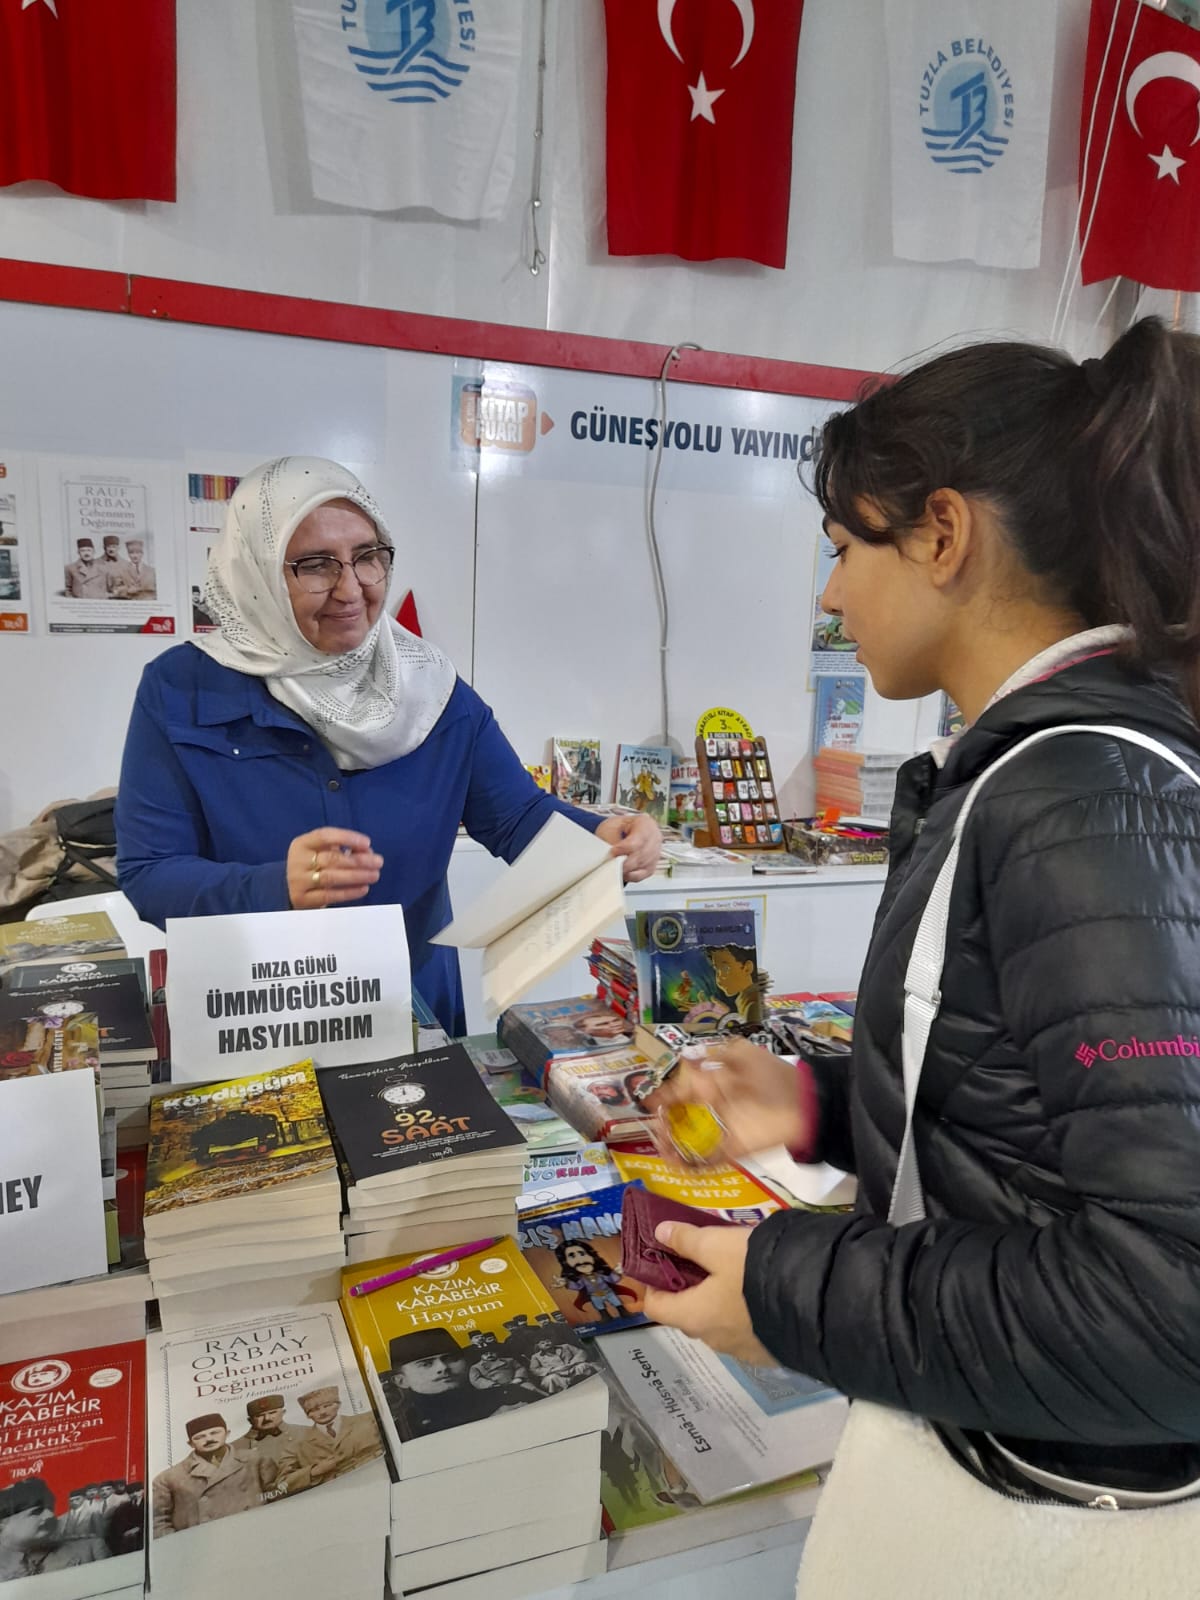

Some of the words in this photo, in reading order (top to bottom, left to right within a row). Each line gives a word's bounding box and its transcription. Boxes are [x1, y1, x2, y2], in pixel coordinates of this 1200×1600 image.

[919, 50, 949, 116] TUZLA
[570, 405, 722, 453] GÜNEŞYOLU
[294, 953, 337, 976] GÜNÜ
[206, 976, 381, 1019] ÜMMÜGÜLSÜM
[218, 1014, 373, 1054] HASYILDIRIM
[380, 1116, 471, 1145] SAAT
[394, 1109, 447, 1127] 92.
[396, 1281, 504, 1312] KARABEKİR
[412, 1276, 476, 1296] KAZIM
[409, 1298, 505, 1326] Hayatım
[191, 1336, 308, 1370] ORBAY
[205, 1325, 292, 1353] RAUF
[193, 1352, 312, 1383] Cehennem
[197, 1363, 314, 1397] Değirmeni
[0, 1388, 76, 1413] KAZIM
[0, 1397, 102, 1428] RABEKİR
[16, 1416, 104, 1442] Hristiyan
